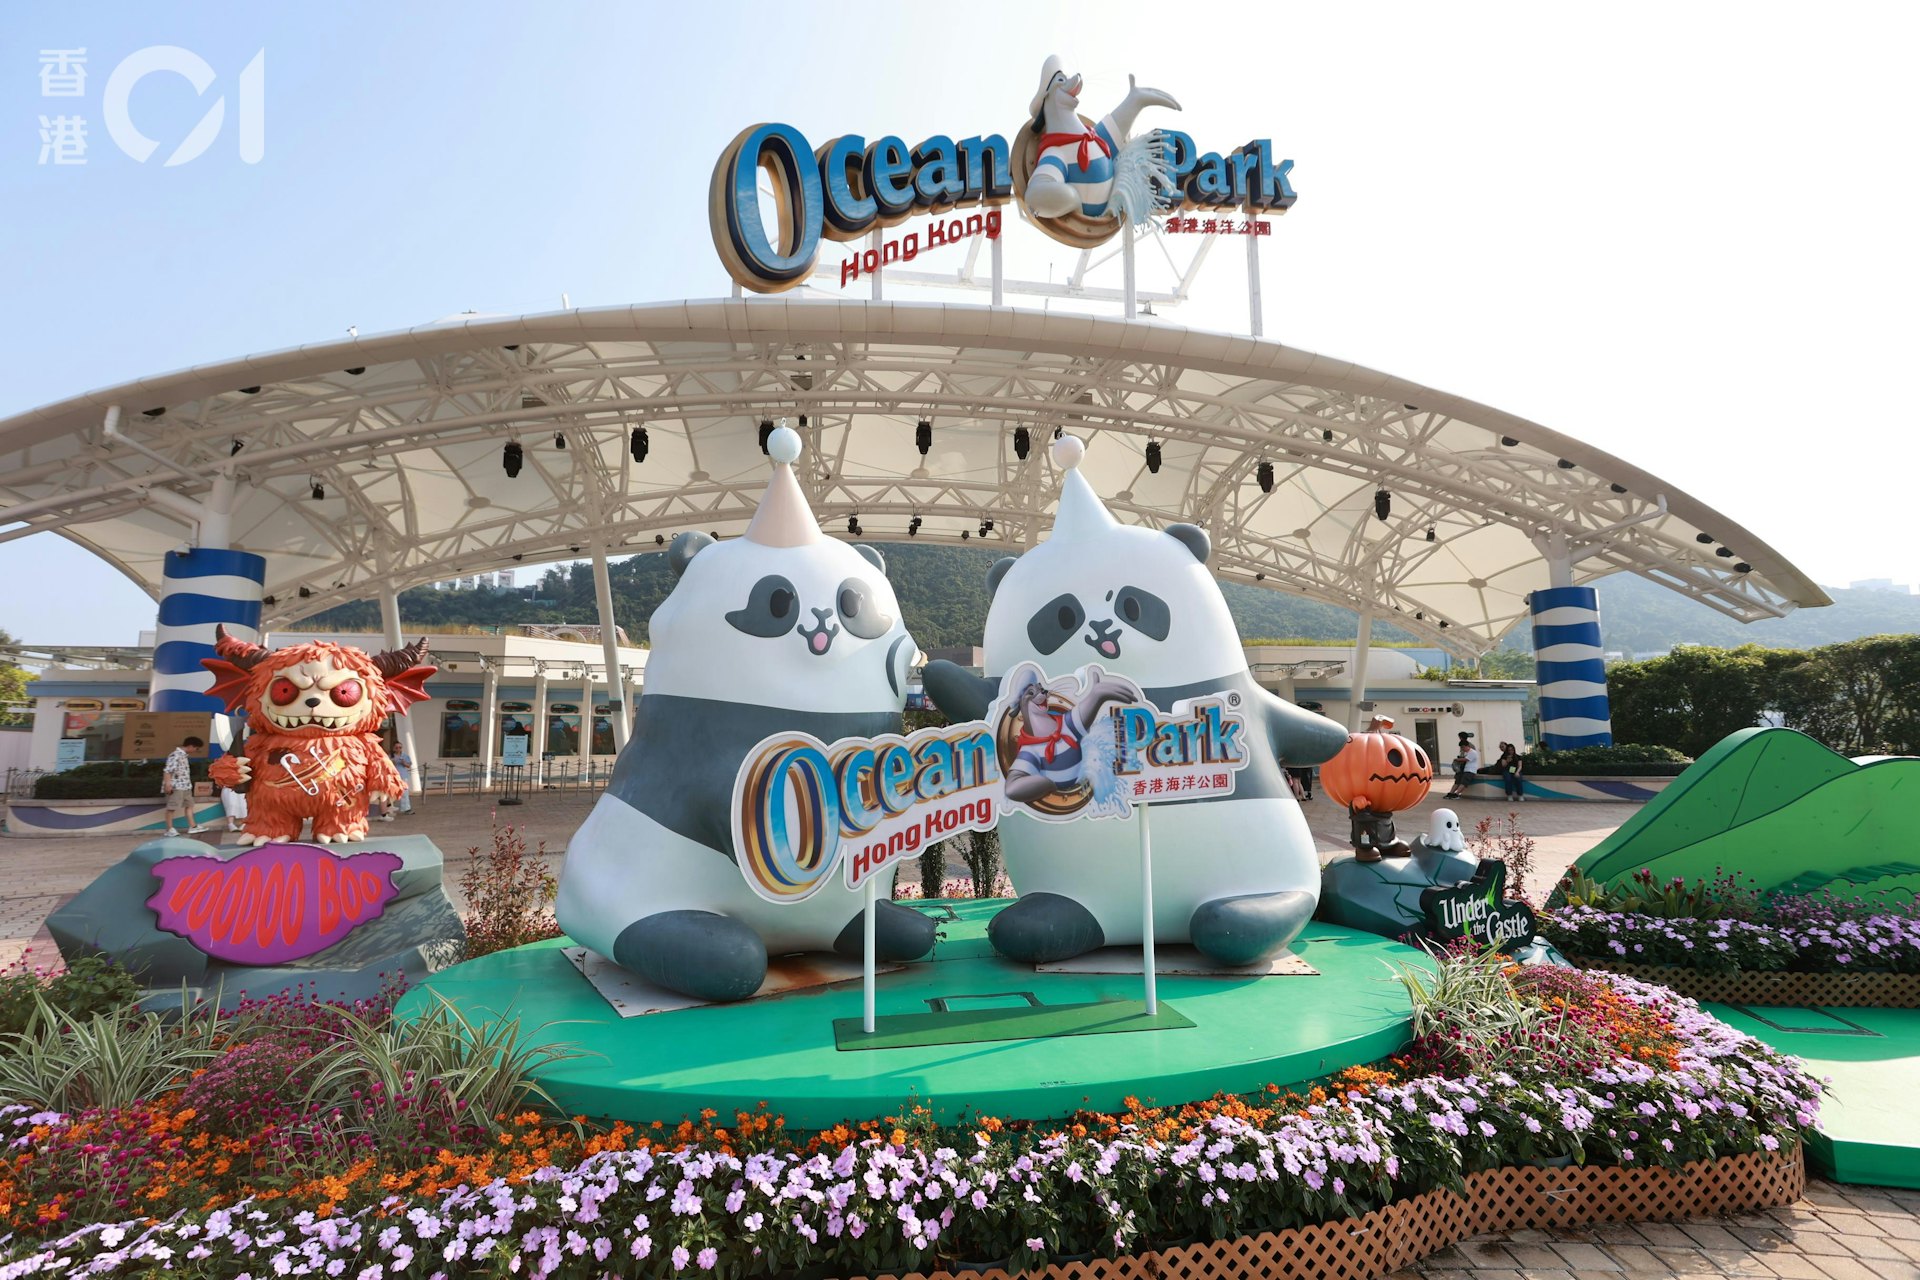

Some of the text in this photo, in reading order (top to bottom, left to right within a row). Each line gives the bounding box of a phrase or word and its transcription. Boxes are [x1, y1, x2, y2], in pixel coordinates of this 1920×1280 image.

[710, 122, 1297, 292] Ocean Park
[1164, 217, 1271, 236] 香港海洋公園
[841, 210, 1002, 288] Hong Kong
[742, 704, 1242, 894] Ocean Park
[1132, 773, 1228, 796] 香港海洋公園
[853, 798, 991, 882] Hong Kong
[168, 857, 382, 948] VOODOO BOO
[1439, 894, 1488, 929] Under
[1473, 911, 1530, 946] the Castle
